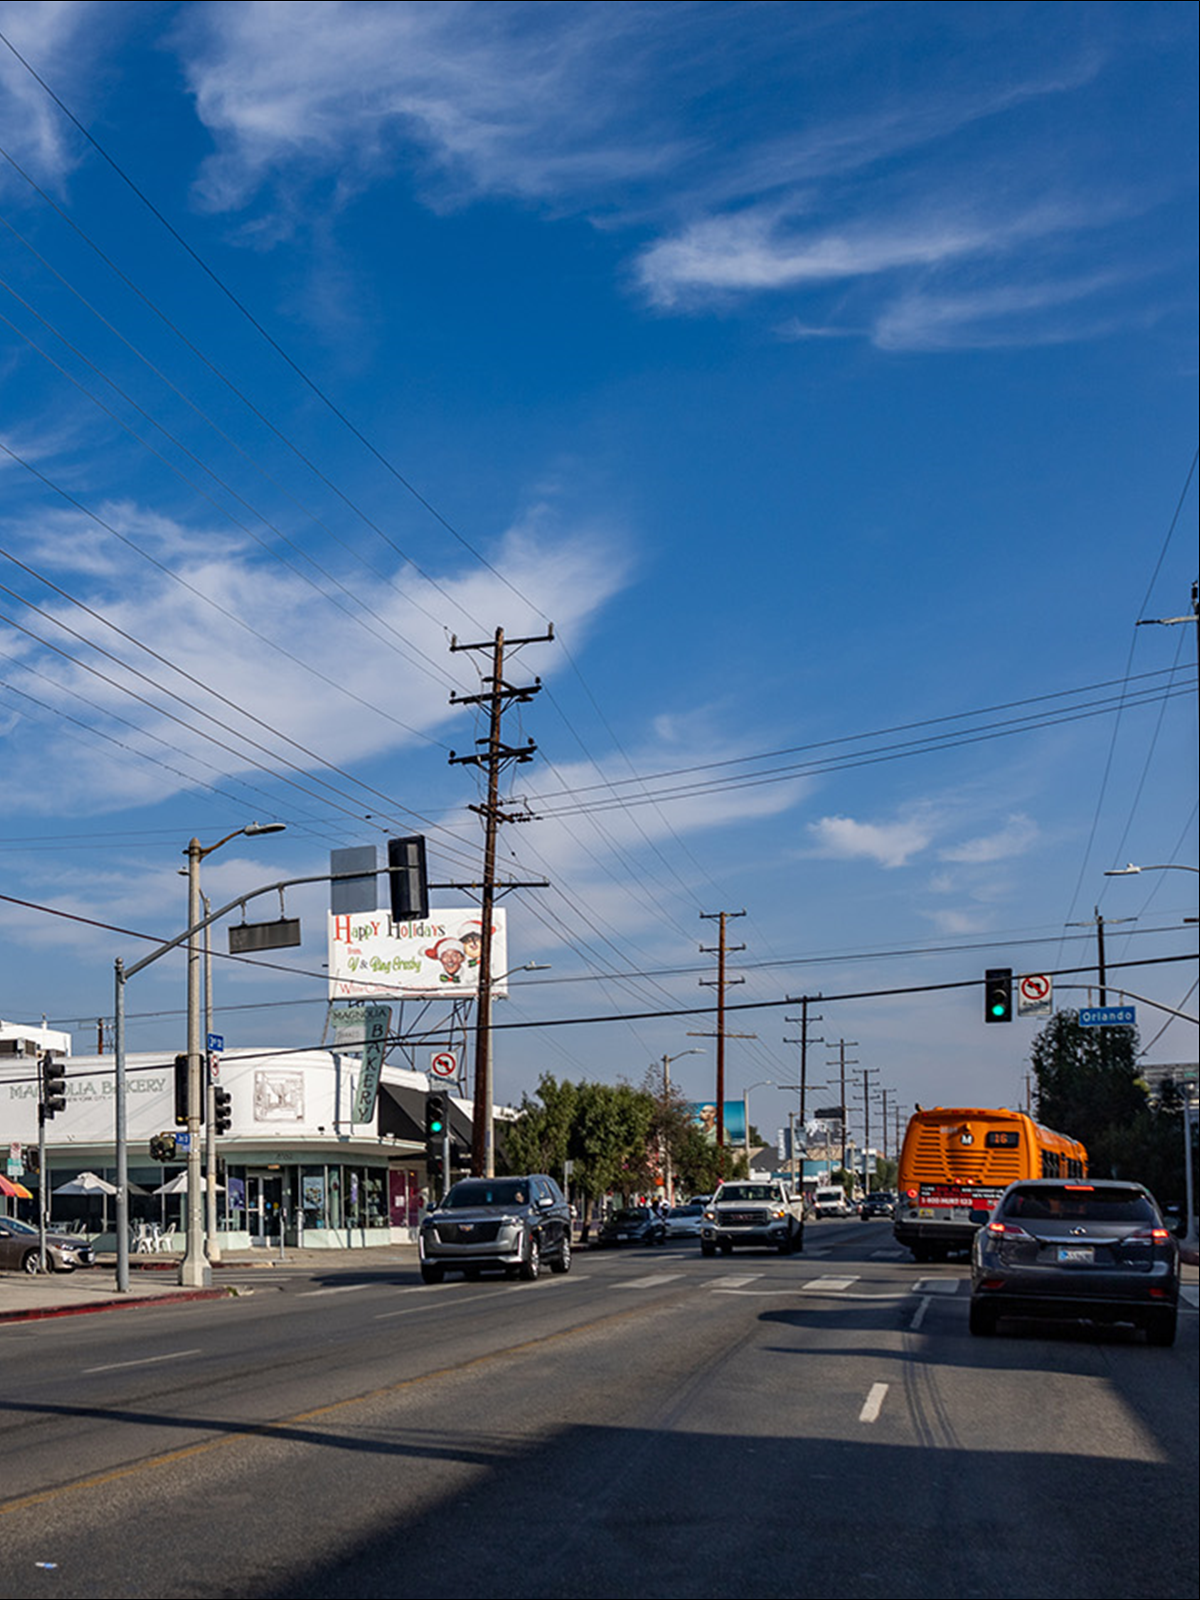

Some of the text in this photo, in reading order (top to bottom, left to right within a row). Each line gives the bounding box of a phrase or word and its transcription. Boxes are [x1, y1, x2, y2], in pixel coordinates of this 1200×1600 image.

[333, 1009, 387, 1020] MAGNOLIA
[1082, 1009, 1132, 1023] Orlando
[358, 1023, 383, 1121] BAKERY
[101, 1079, 166, 1096] BKERY
[994, 1133, 1008, 1144] 16
